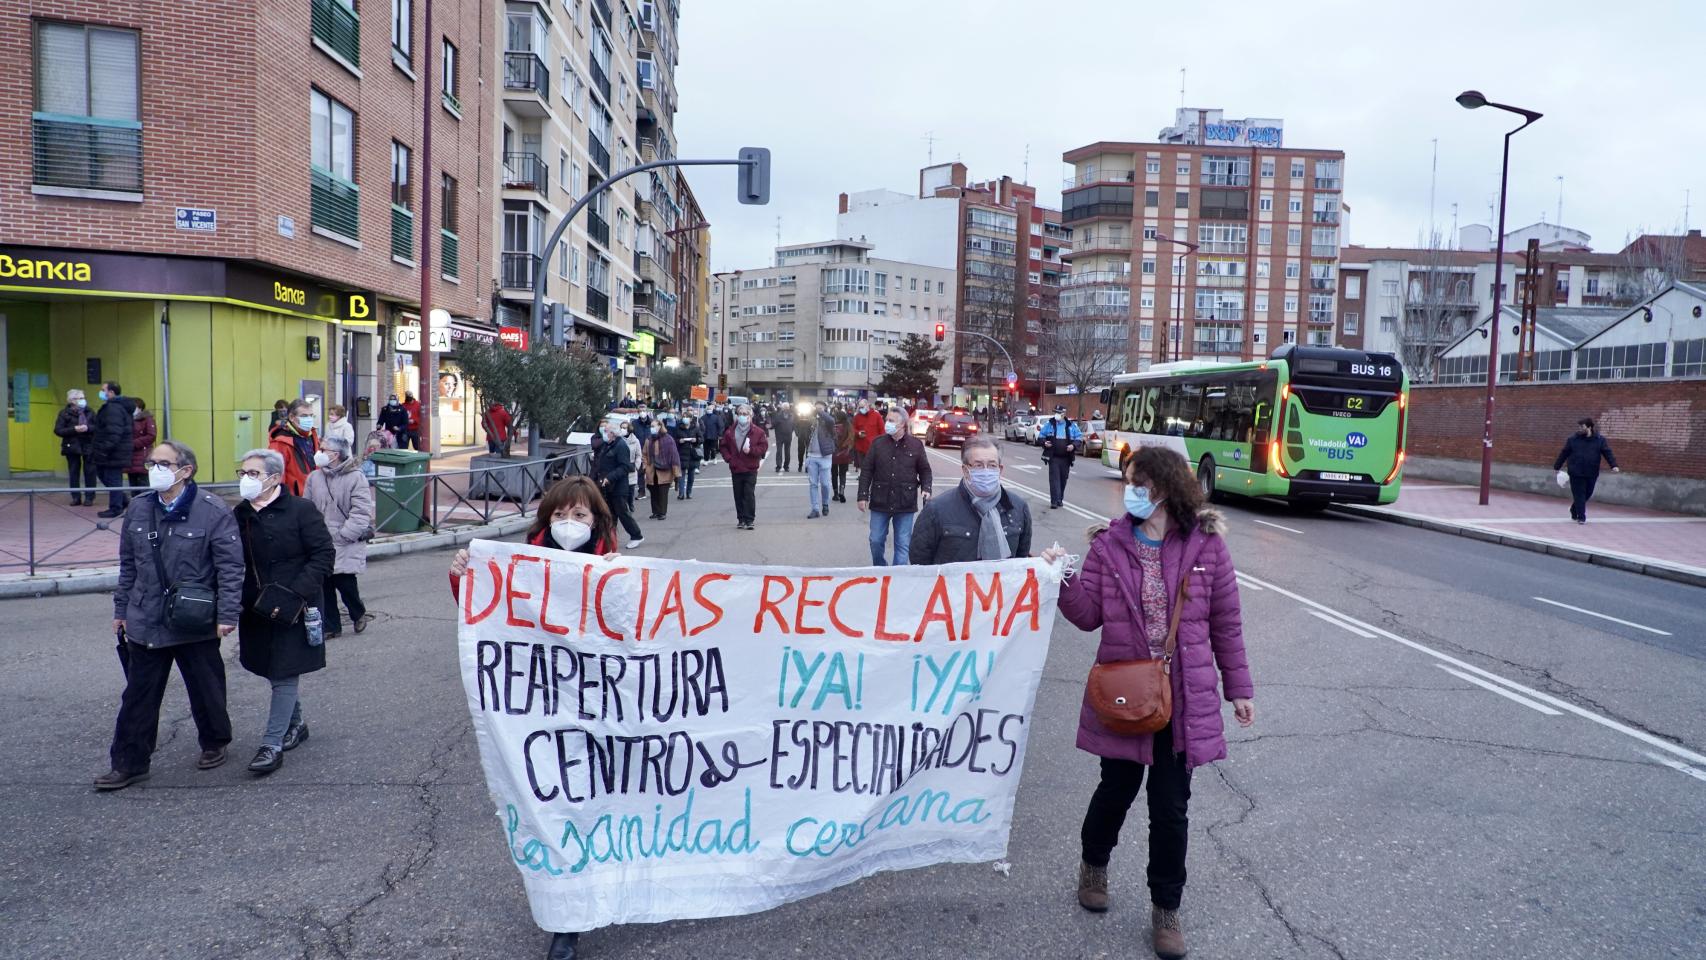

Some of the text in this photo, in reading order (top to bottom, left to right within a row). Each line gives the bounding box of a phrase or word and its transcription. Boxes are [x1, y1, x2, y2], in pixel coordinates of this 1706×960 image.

[177, 220, 214, 229] SAN VICENTE
[0, 254, 92, 281] Bankia
[274, 281, 305, 306] Bankia
[349, 295, 369, 318] B
[500, 332, 519, 341] GAES
[1351, 363, 1391, 376] BUS 16
[1121, 386, 1160, 433] BUS
[1347, 397, 1363, 410] C2
[1309, 435, 1365, 448] Valladolid VA!
[1328, 447, 1354, 460] BUS
[464, 554, 1040, 642] DELICIAS RECLAMA
[477, 640, 729, 722] REAPERTURA
[778, 646, 864, 711] ¡YA!
[524, 729, 693, 803] CENTRO
[696, 741, 767, 788] de
[506, 803, 562, 875] la
[561, 787, 760, 873] sanidad
